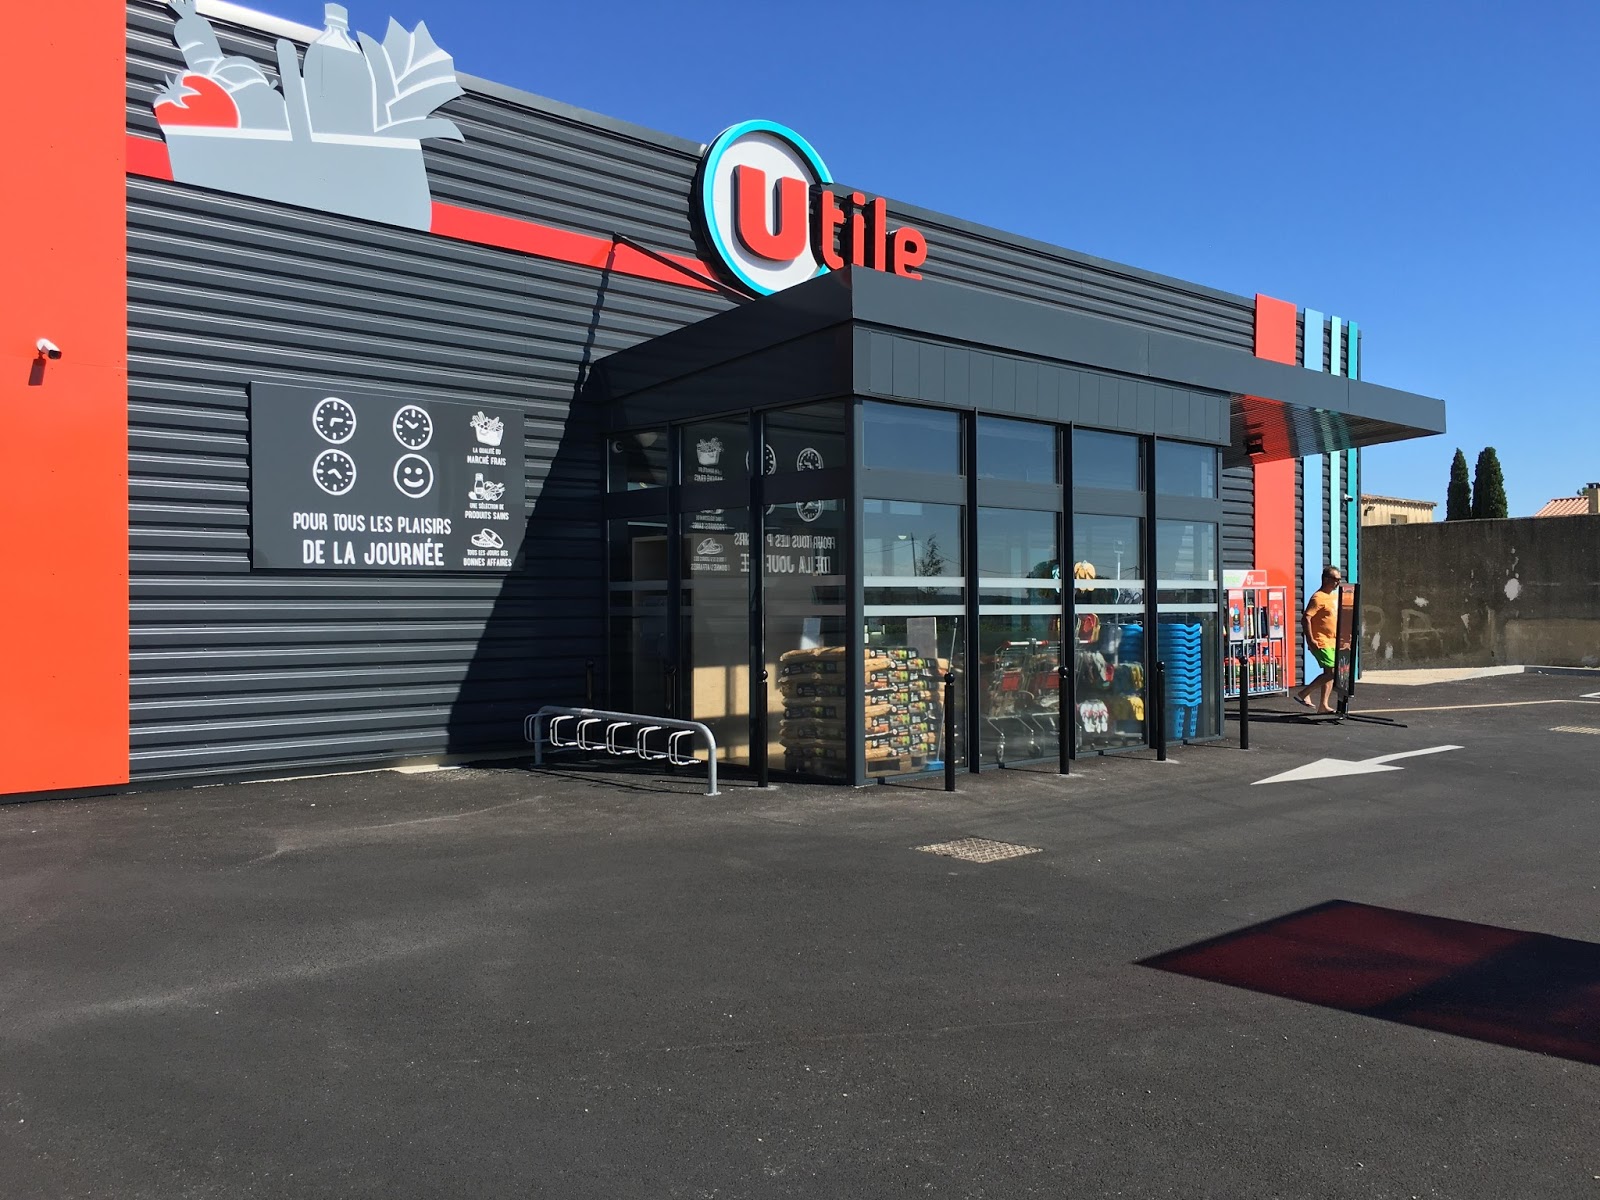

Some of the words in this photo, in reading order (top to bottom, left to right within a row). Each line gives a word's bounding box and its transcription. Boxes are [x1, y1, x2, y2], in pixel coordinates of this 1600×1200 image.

[466, 455, 490, 465] MARCHÉ
[490, 456, 507, 466] FRAIS
[464, 510, 492, 520] PRODUITS
[492, 511, 510, 521] SAINS
[292, 512, 328, 531] POUR
[333, 513, 366, 532] TOUS
[370, 515, 393, 533] LES
[397, 516, 452, 535] PLAISIRS
[302, 539, 326, 564] DE
[333, 541, 356, 565] LA
[363, 537, 445, 566] JOURNÉE
[463, 557, 486, 567] BONNES
[486, 558, 512, 568] AFFAIRES
